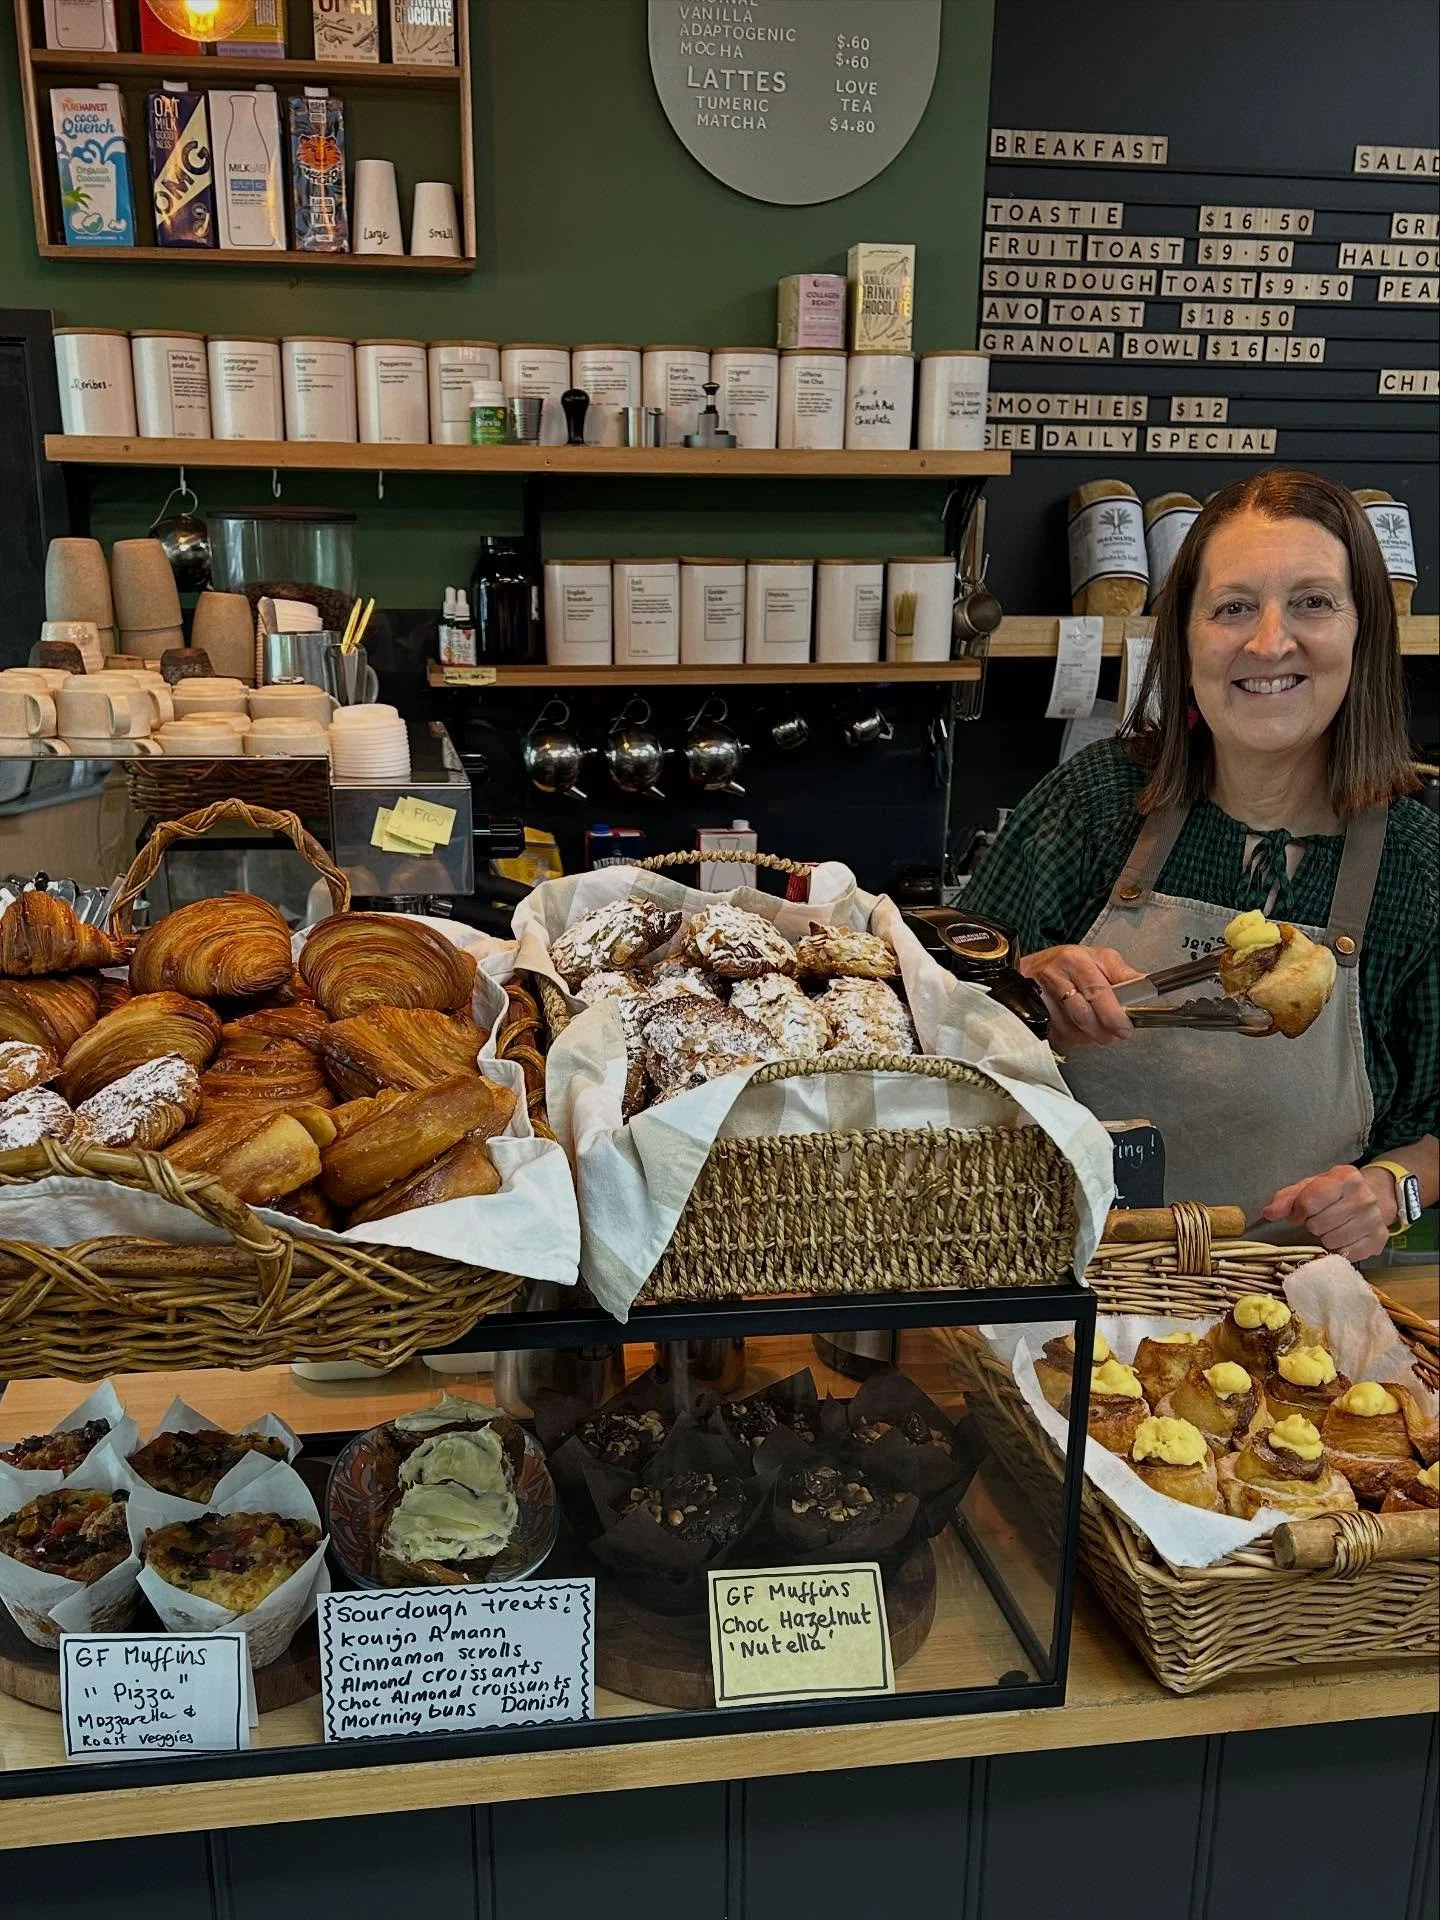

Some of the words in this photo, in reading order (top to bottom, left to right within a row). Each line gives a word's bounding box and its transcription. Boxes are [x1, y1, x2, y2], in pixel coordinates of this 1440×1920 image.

[680, 6, 753, 23] VANILLA
[680, 23, 797, 42] ADAPTOGENIC
[680, 41, 743, 59] MOCHA
[687, 65, 787, 93] LATTES
[836, 79, 878, 96] LOVE
[154, 97, 180, 118] OAT
[696, 95, 769, 113] TUMERIC
[841, 98, 873, 114] TEA
[62, 117, 115, 139] Quench
[697, 113, 767, 130] MATCHA
[996, 136, 1163, 160] BREAKFAST
[154, 140, 211, 215] OMG
[990, 204, 1118, 224] TOASTIE
[363, 227, 390, 245] Large
[990, 237, 1078, 256] FRUIT
[1092, 241, 1180, 260] TOAST
[988, 270, 1153, 291] SOURDOUGH
[1167, 275, 1252, 294] TOAST
[986, 302, 1038, 320] AVO
[1053, 304, 1141, 323] TOAST
[984, 334, 1111, 354] GRANOLA
[1128, 338, 1193, 356] BOWL
[1176, 402, 1223, 418] $12
[984, 429, 1031, 446] SEE
[1047, 431, 1133, 448] DAILY
[1152, 433, 1271, 450] SPECIAL
[727, 1586, 754, 1606] GF
[769, 1579, 850, 1606] Muffins
[337, 1601, 467, 1634] Sourdough
[722, 1616, 769, 1634] Choc
[780, 1602, 872, 1639] Hazelnut
[76, 1647, 110, 1667] GF
[124, 1644, 208, 1672] Muffins
[339, 1650, 444, 1672] Cinnamon
[341, 1670, 412, 1694] Almond
[422, 1660, 542, 1684] croissants
[391, 1686, 461, 1705] Almond
[78, 1708, 176, 1734] Mozzarella
[342, 1704, 422, 1732] Morning
[428, 1702, 476, 1719] buns
[501, 1689, 570, 1714] Danish
[83, 1734, 127, 1746] Roast
